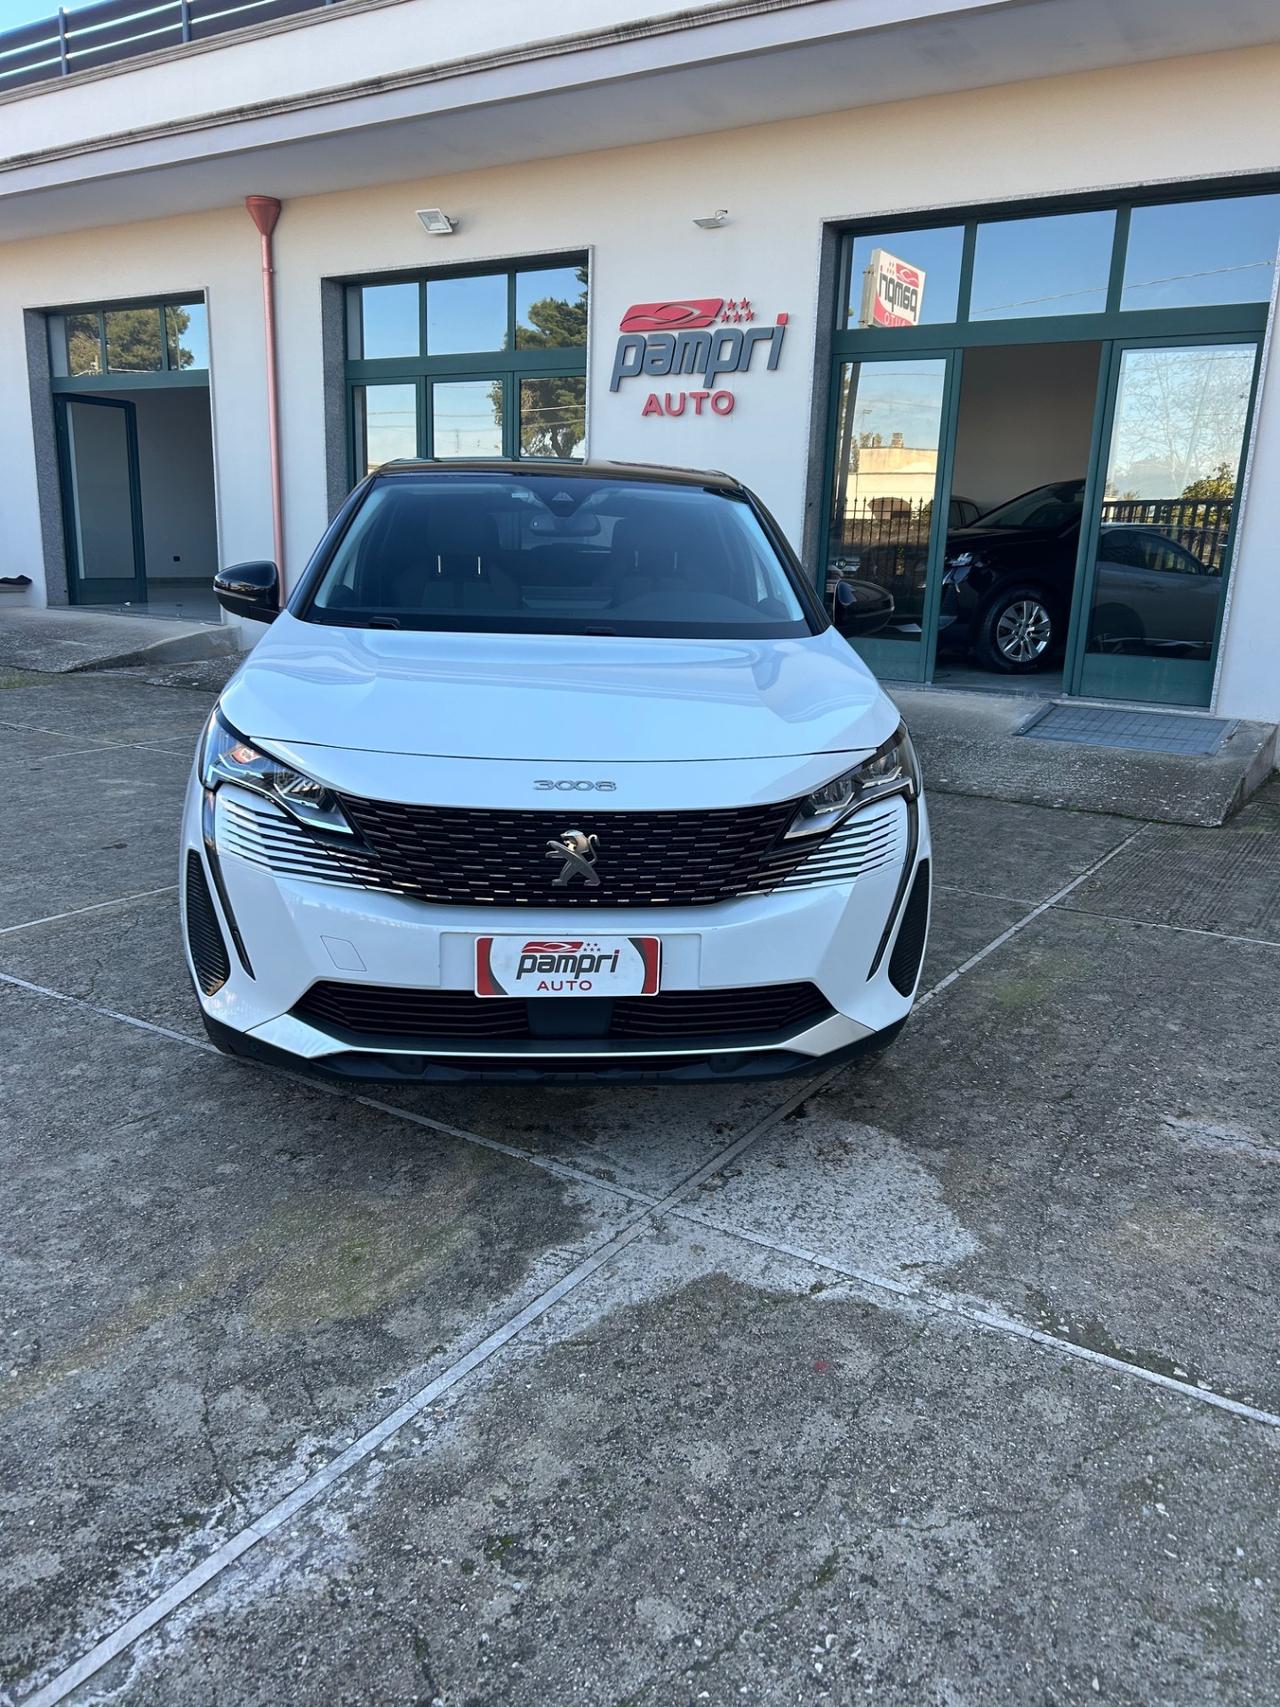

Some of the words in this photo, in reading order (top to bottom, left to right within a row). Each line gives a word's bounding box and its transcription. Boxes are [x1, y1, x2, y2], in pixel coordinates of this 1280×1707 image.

[610, 312, 789, 392] pampri
[641, 390, 736, 416] AUTO
[533, 780, 617, 792] 3008
[516, 949, 620, 980] pampri
[537, 980, 593, 991] AUTO
